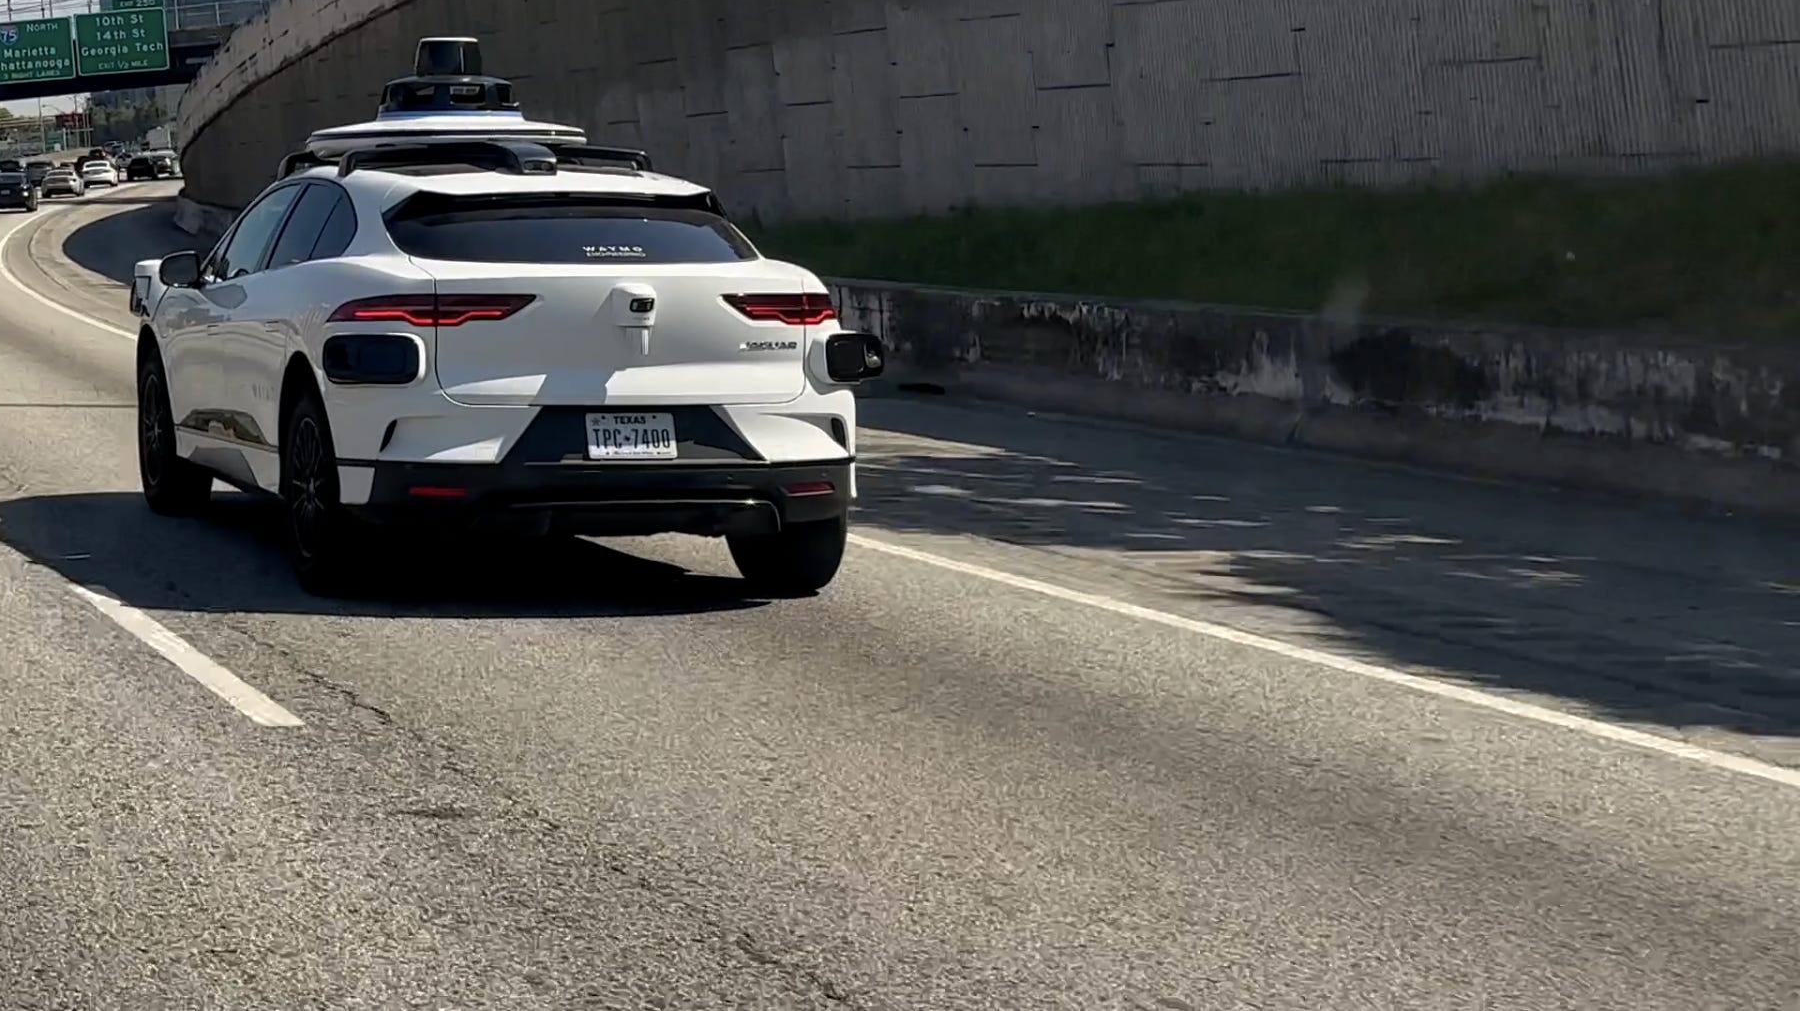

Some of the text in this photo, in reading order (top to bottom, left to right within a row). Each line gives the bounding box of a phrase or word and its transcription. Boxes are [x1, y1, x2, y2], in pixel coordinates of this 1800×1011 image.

[95, 14, 144, 27] 10th St
[25, 22, 59, 33] NORTH
[0, 30, 18, 44] 75
[96, 28, 146, 41] 14th St
[3, 45, 57, 59] Marietta
[81, 41, 164, 57] Georgia Tech
[613, 415, 647, 425] TEXAS
